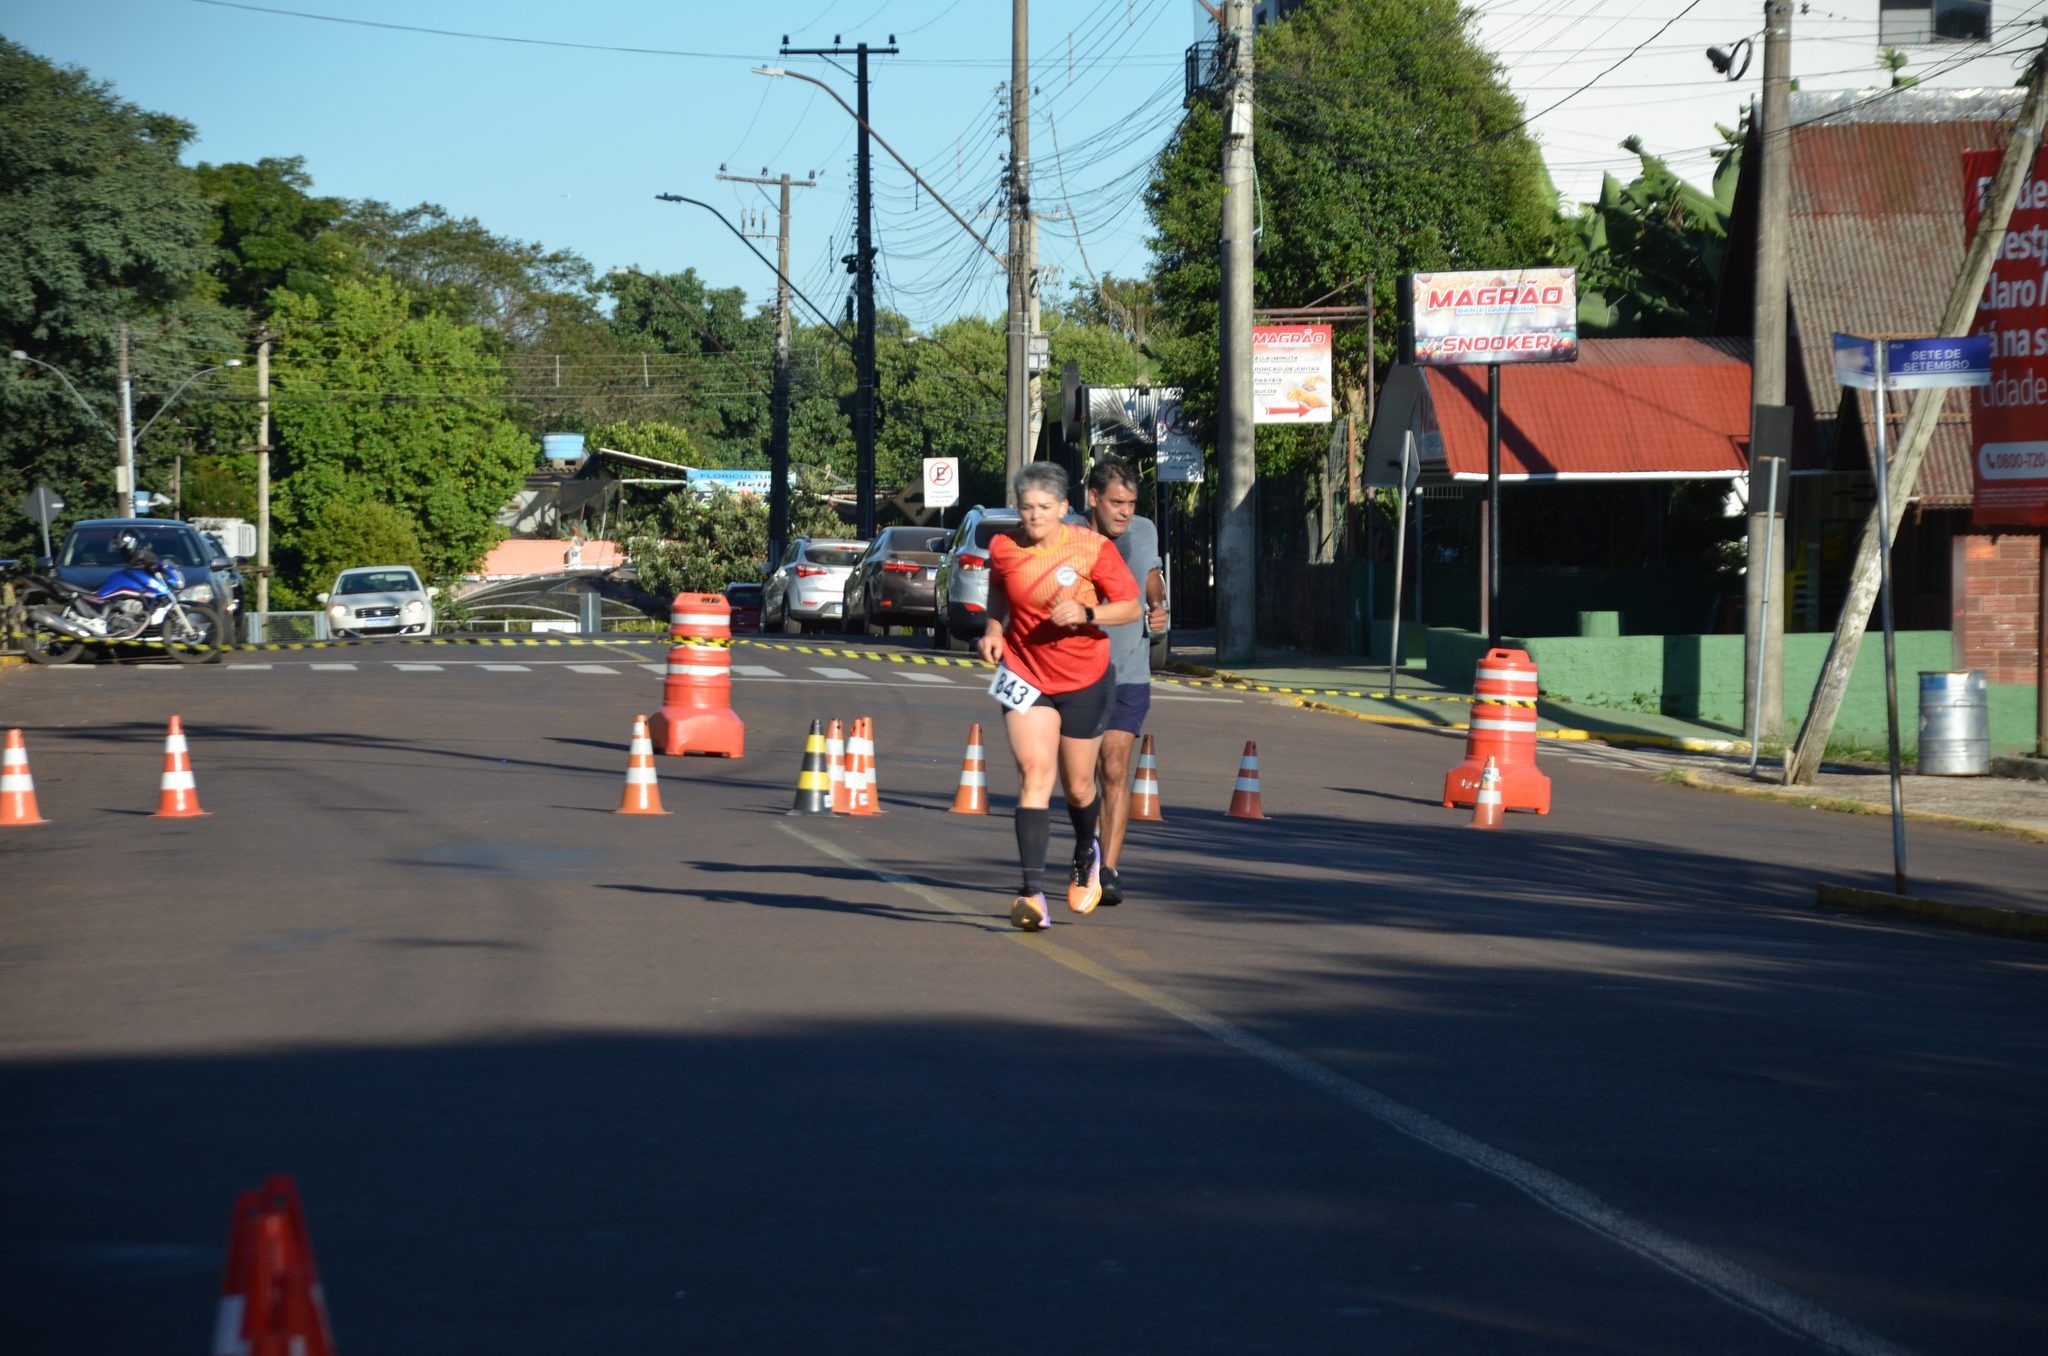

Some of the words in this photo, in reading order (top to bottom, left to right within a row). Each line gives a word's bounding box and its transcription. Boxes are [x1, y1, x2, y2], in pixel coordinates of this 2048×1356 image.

[1428, 279, 1564, 308] MAGRÃO
[1253, 328, 1326, 344] MAGRÃO
[1442, 335, 1552, 353] SNOOKER
[2003, 328, 2031, 358] na
[1911, 349, 1942, 361] SETE
[1945, 348, 1962, 359] DE
[1903, 359, 1970, 372] SETEMBRO
[995, 671, 1029, 705] 843
